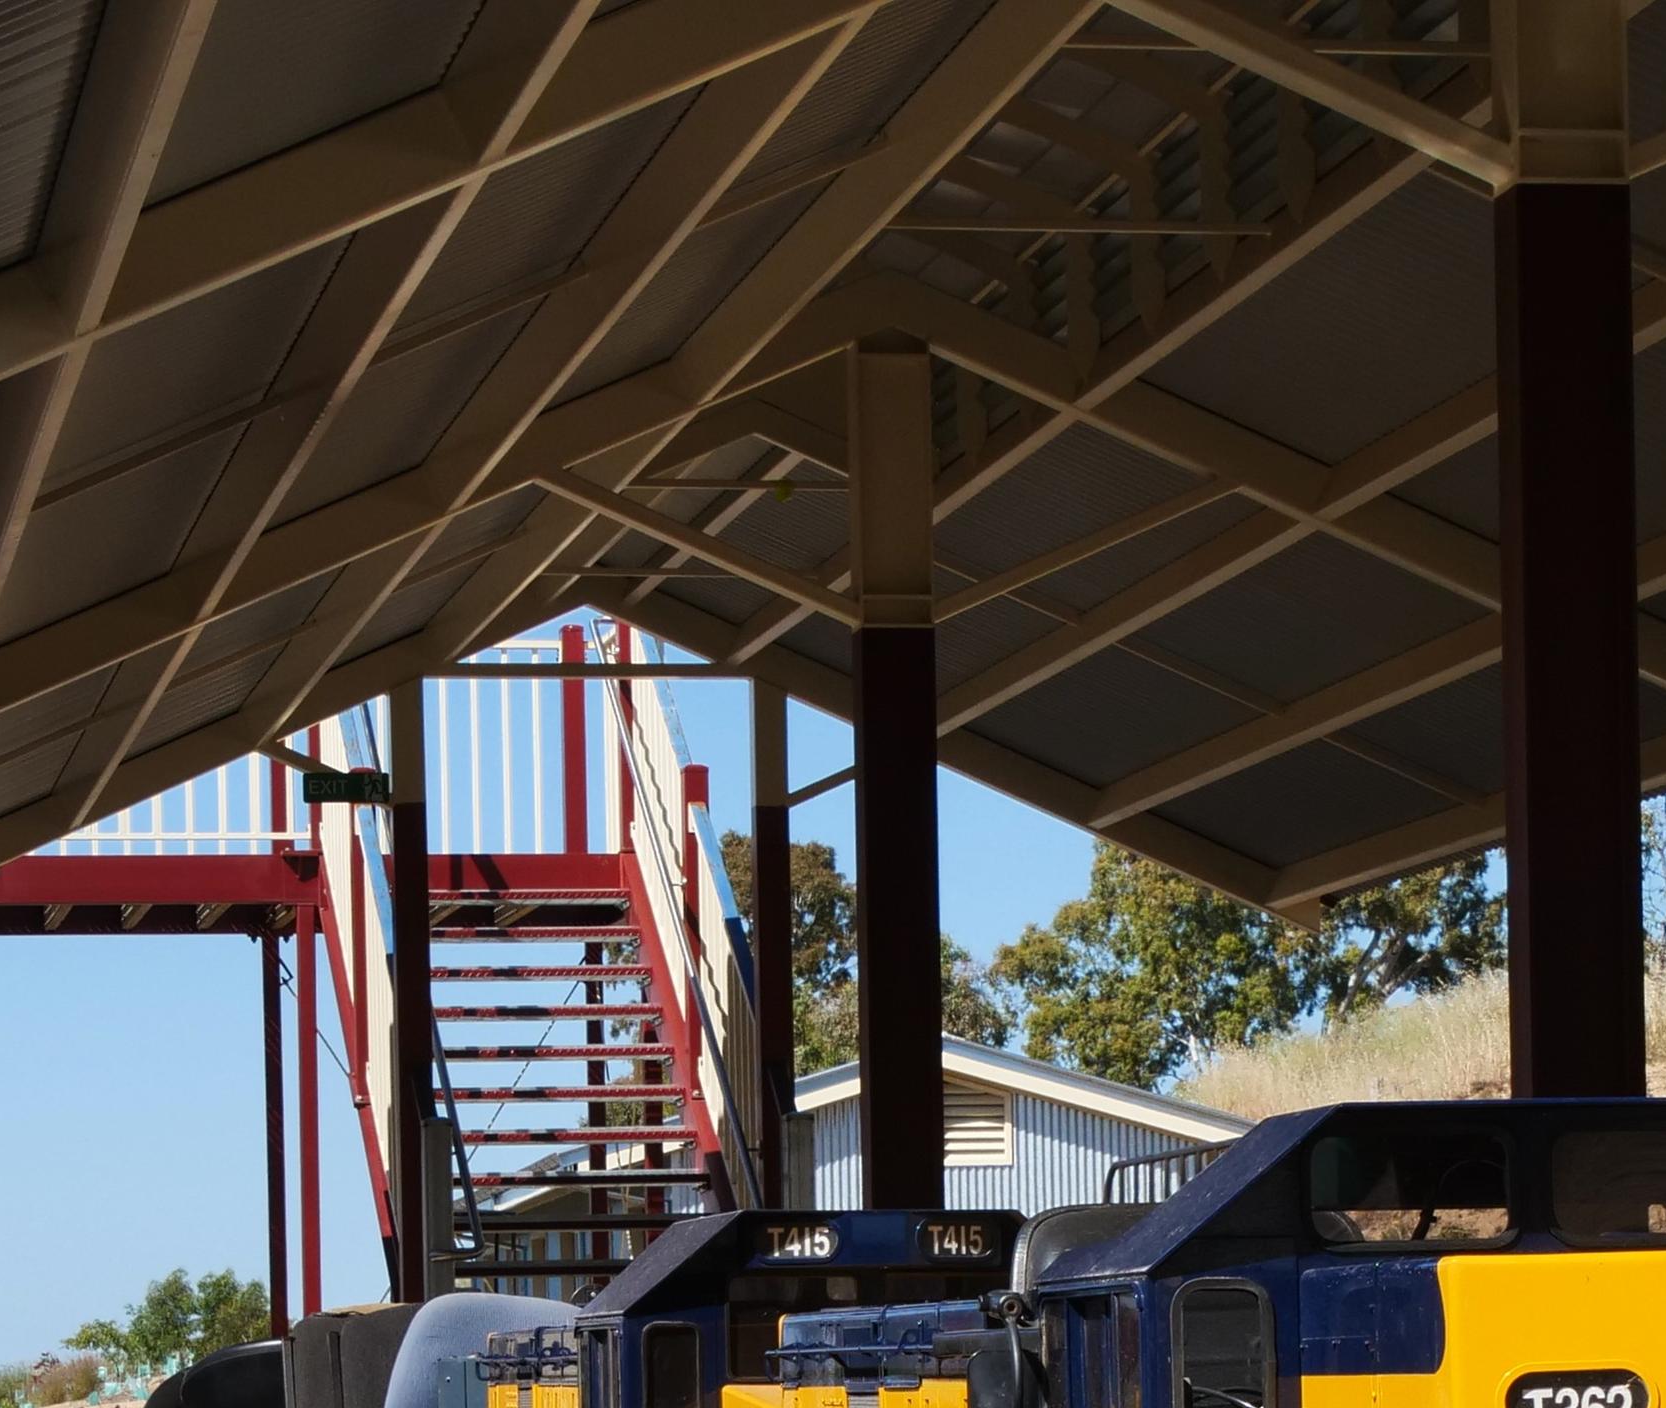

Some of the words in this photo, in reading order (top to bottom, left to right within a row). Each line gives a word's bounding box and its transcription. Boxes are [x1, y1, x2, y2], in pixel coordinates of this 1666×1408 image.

[308, 780, 348, 794] EXIT
[767, 1226, 831, 1257] T415
[927, 1225, 983, 1255] T415
